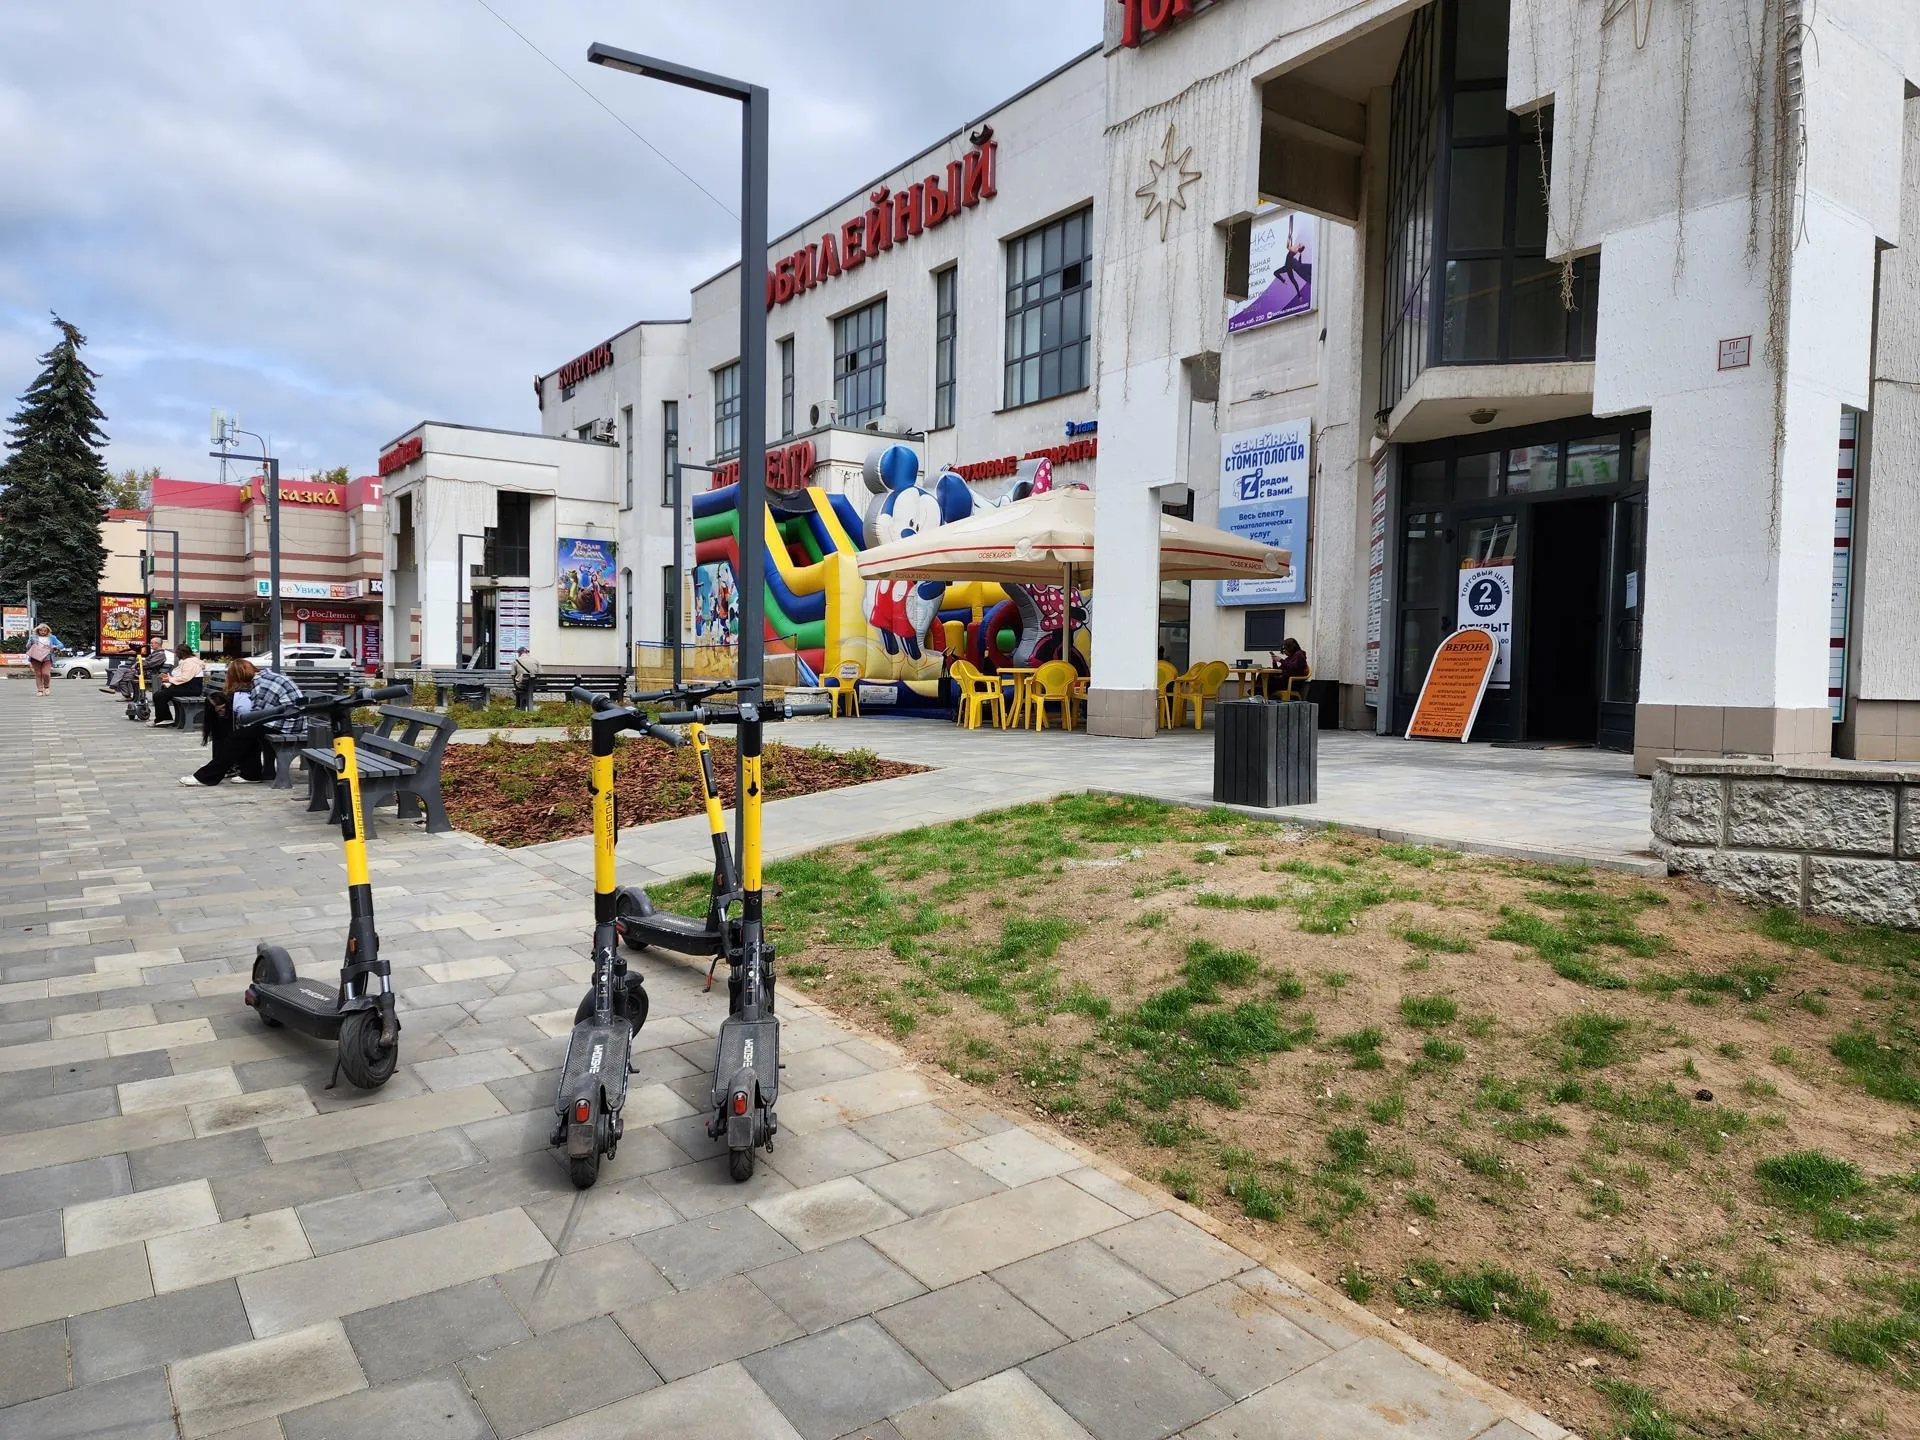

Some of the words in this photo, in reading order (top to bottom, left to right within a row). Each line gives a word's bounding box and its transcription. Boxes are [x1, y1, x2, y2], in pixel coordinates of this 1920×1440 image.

[1232, 431, 1299, 455] СЕМЕЙНАЯ
[1225, 444, 1305, 472] СТОМАТОЛОГИЯ
[1260, 476, 1289, 488] рядом
[1267, 485, 1293, 497] Вами!
[1239, 513, 1256, 521] Весь
[1257, 509, 1285, 519] спектр
[1230, 519, 1293, 531] стоматологических
[1249, 530, 1271, 540] услуг
[1462, 570, 1493, 597] ТОРГОВЫЙ
[1494, 573, 1510, 595] ЦЕНТР
[1479, 582, 1493, 603] 2
[1473, 603, 1497, 612] ЭТАЖ
[311, 610, 356, 620] РосДеньги
[1445, 643, 1490, 652] ВЕРОНА
